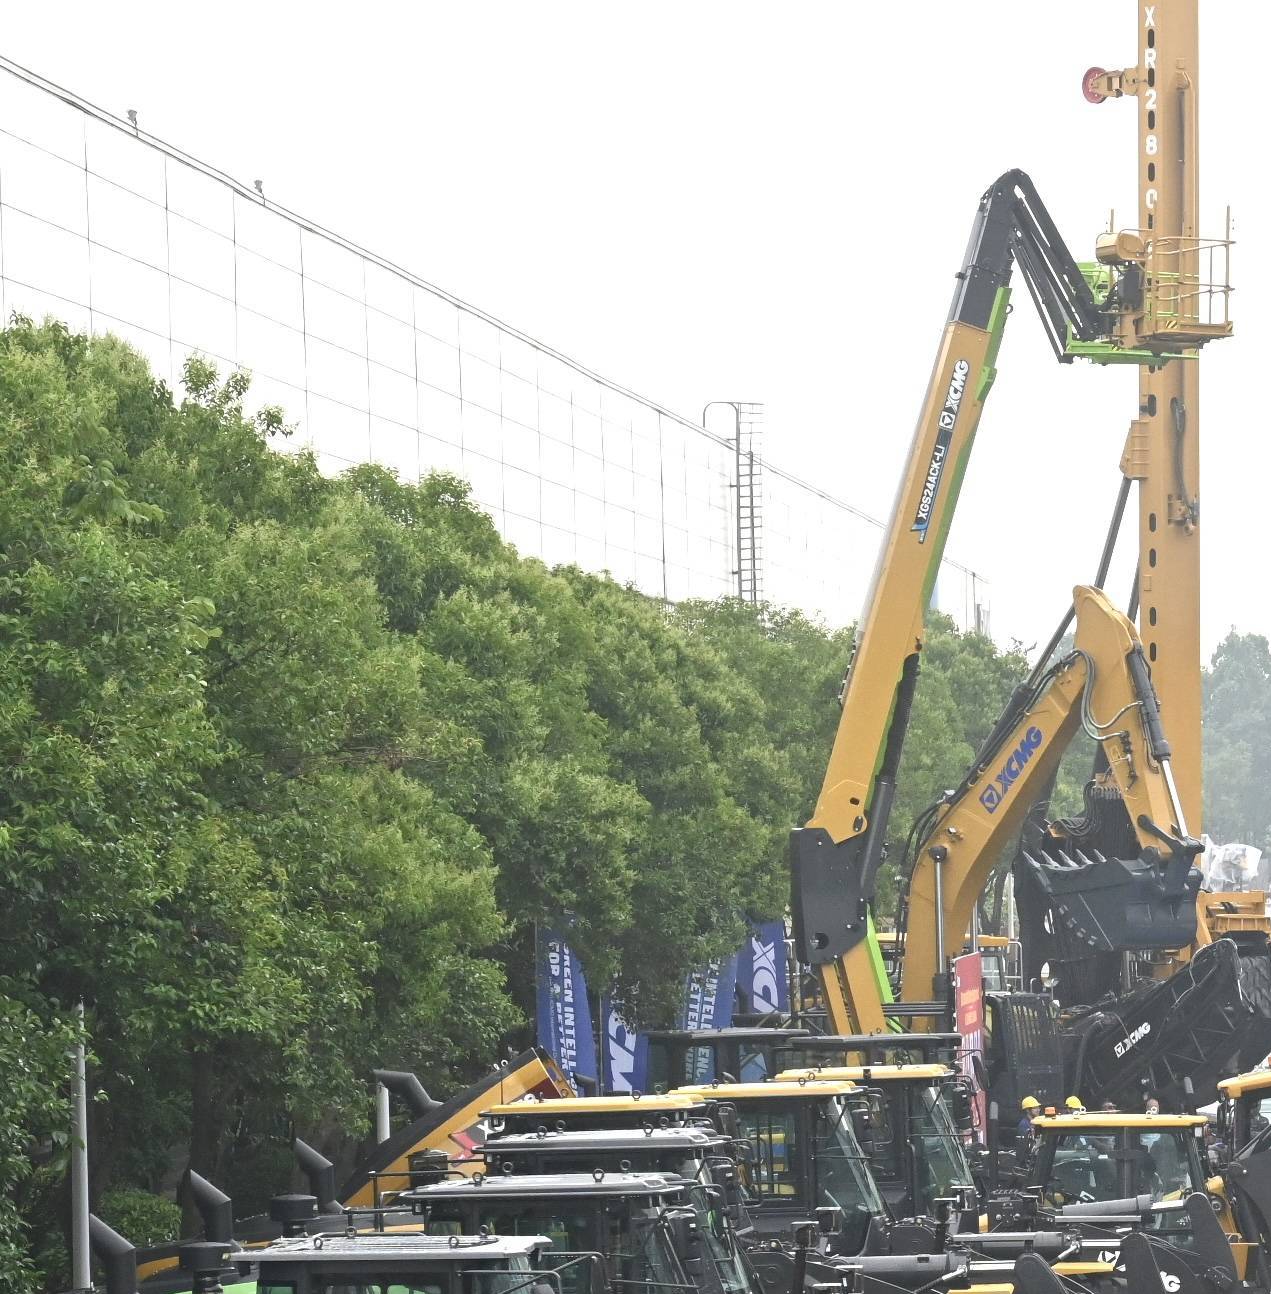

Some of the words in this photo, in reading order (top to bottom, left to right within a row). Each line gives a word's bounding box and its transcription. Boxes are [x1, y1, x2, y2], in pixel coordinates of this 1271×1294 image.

[944, 360, 969, 414] XCMG
[996, 725, 1043, 791] XCMG
[752, 937, 779, 1014] XC
[1124, 1022, 1151, 1051] XCMG
